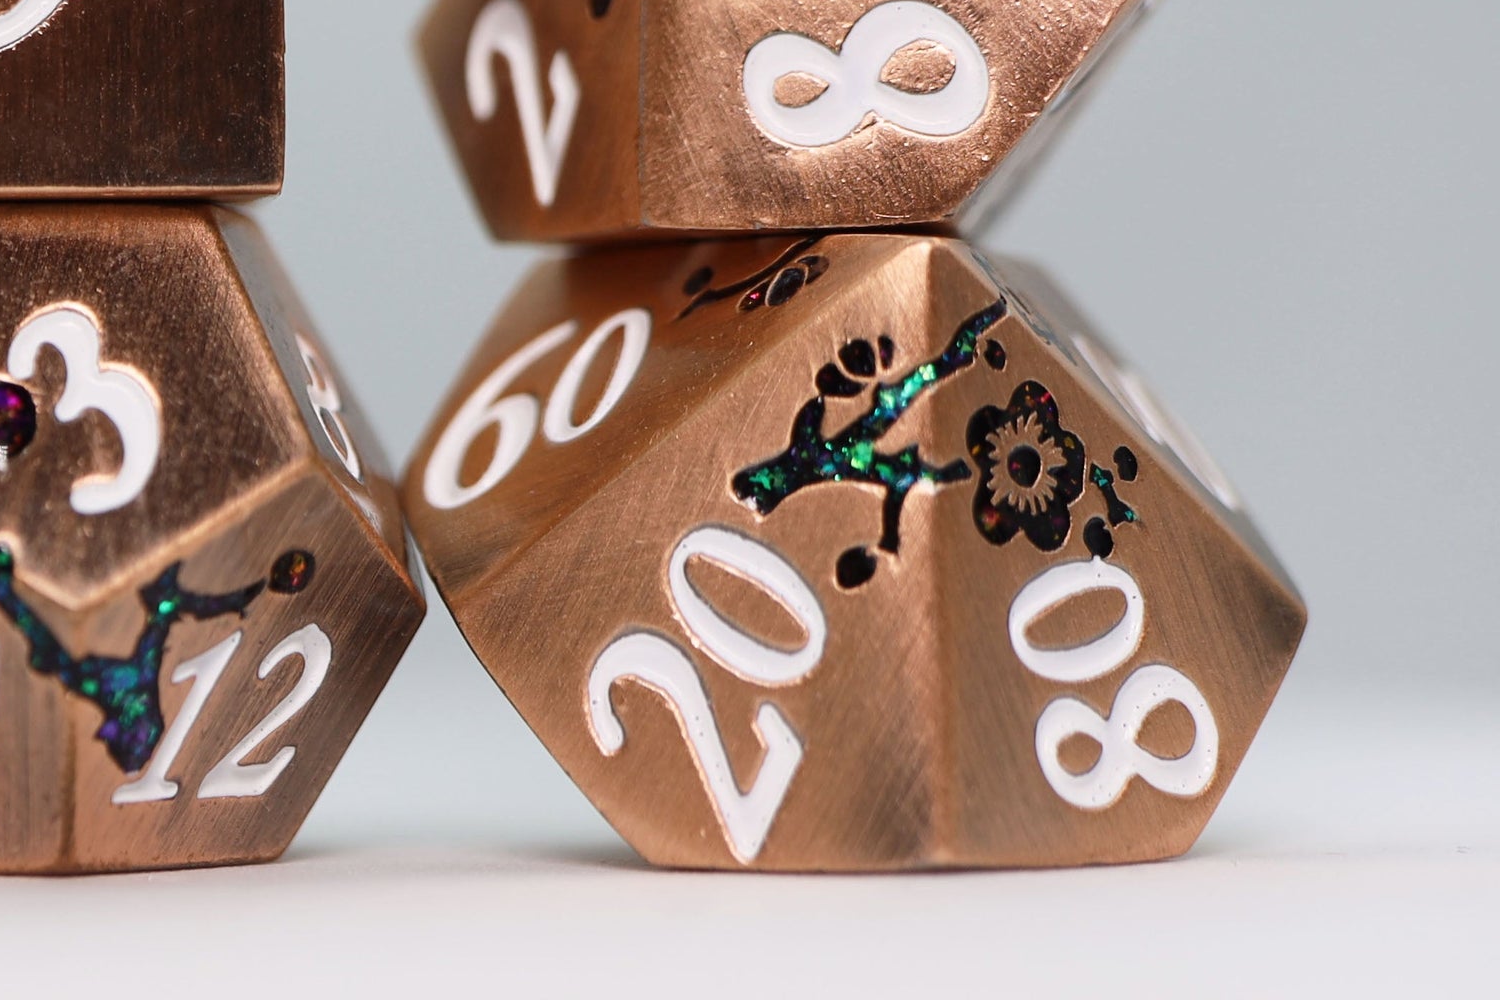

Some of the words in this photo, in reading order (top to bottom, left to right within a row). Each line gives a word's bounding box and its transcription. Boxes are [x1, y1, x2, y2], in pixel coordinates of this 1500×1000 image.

[743, 0, 990, 148] 8
[7, 307, 160, 516] 3
[422, 308, 652, 509] 60
[112, 623, 333, 804] 12
[583, 524, 827, 864] 20
[1008, 556, 1218, 809] 80
